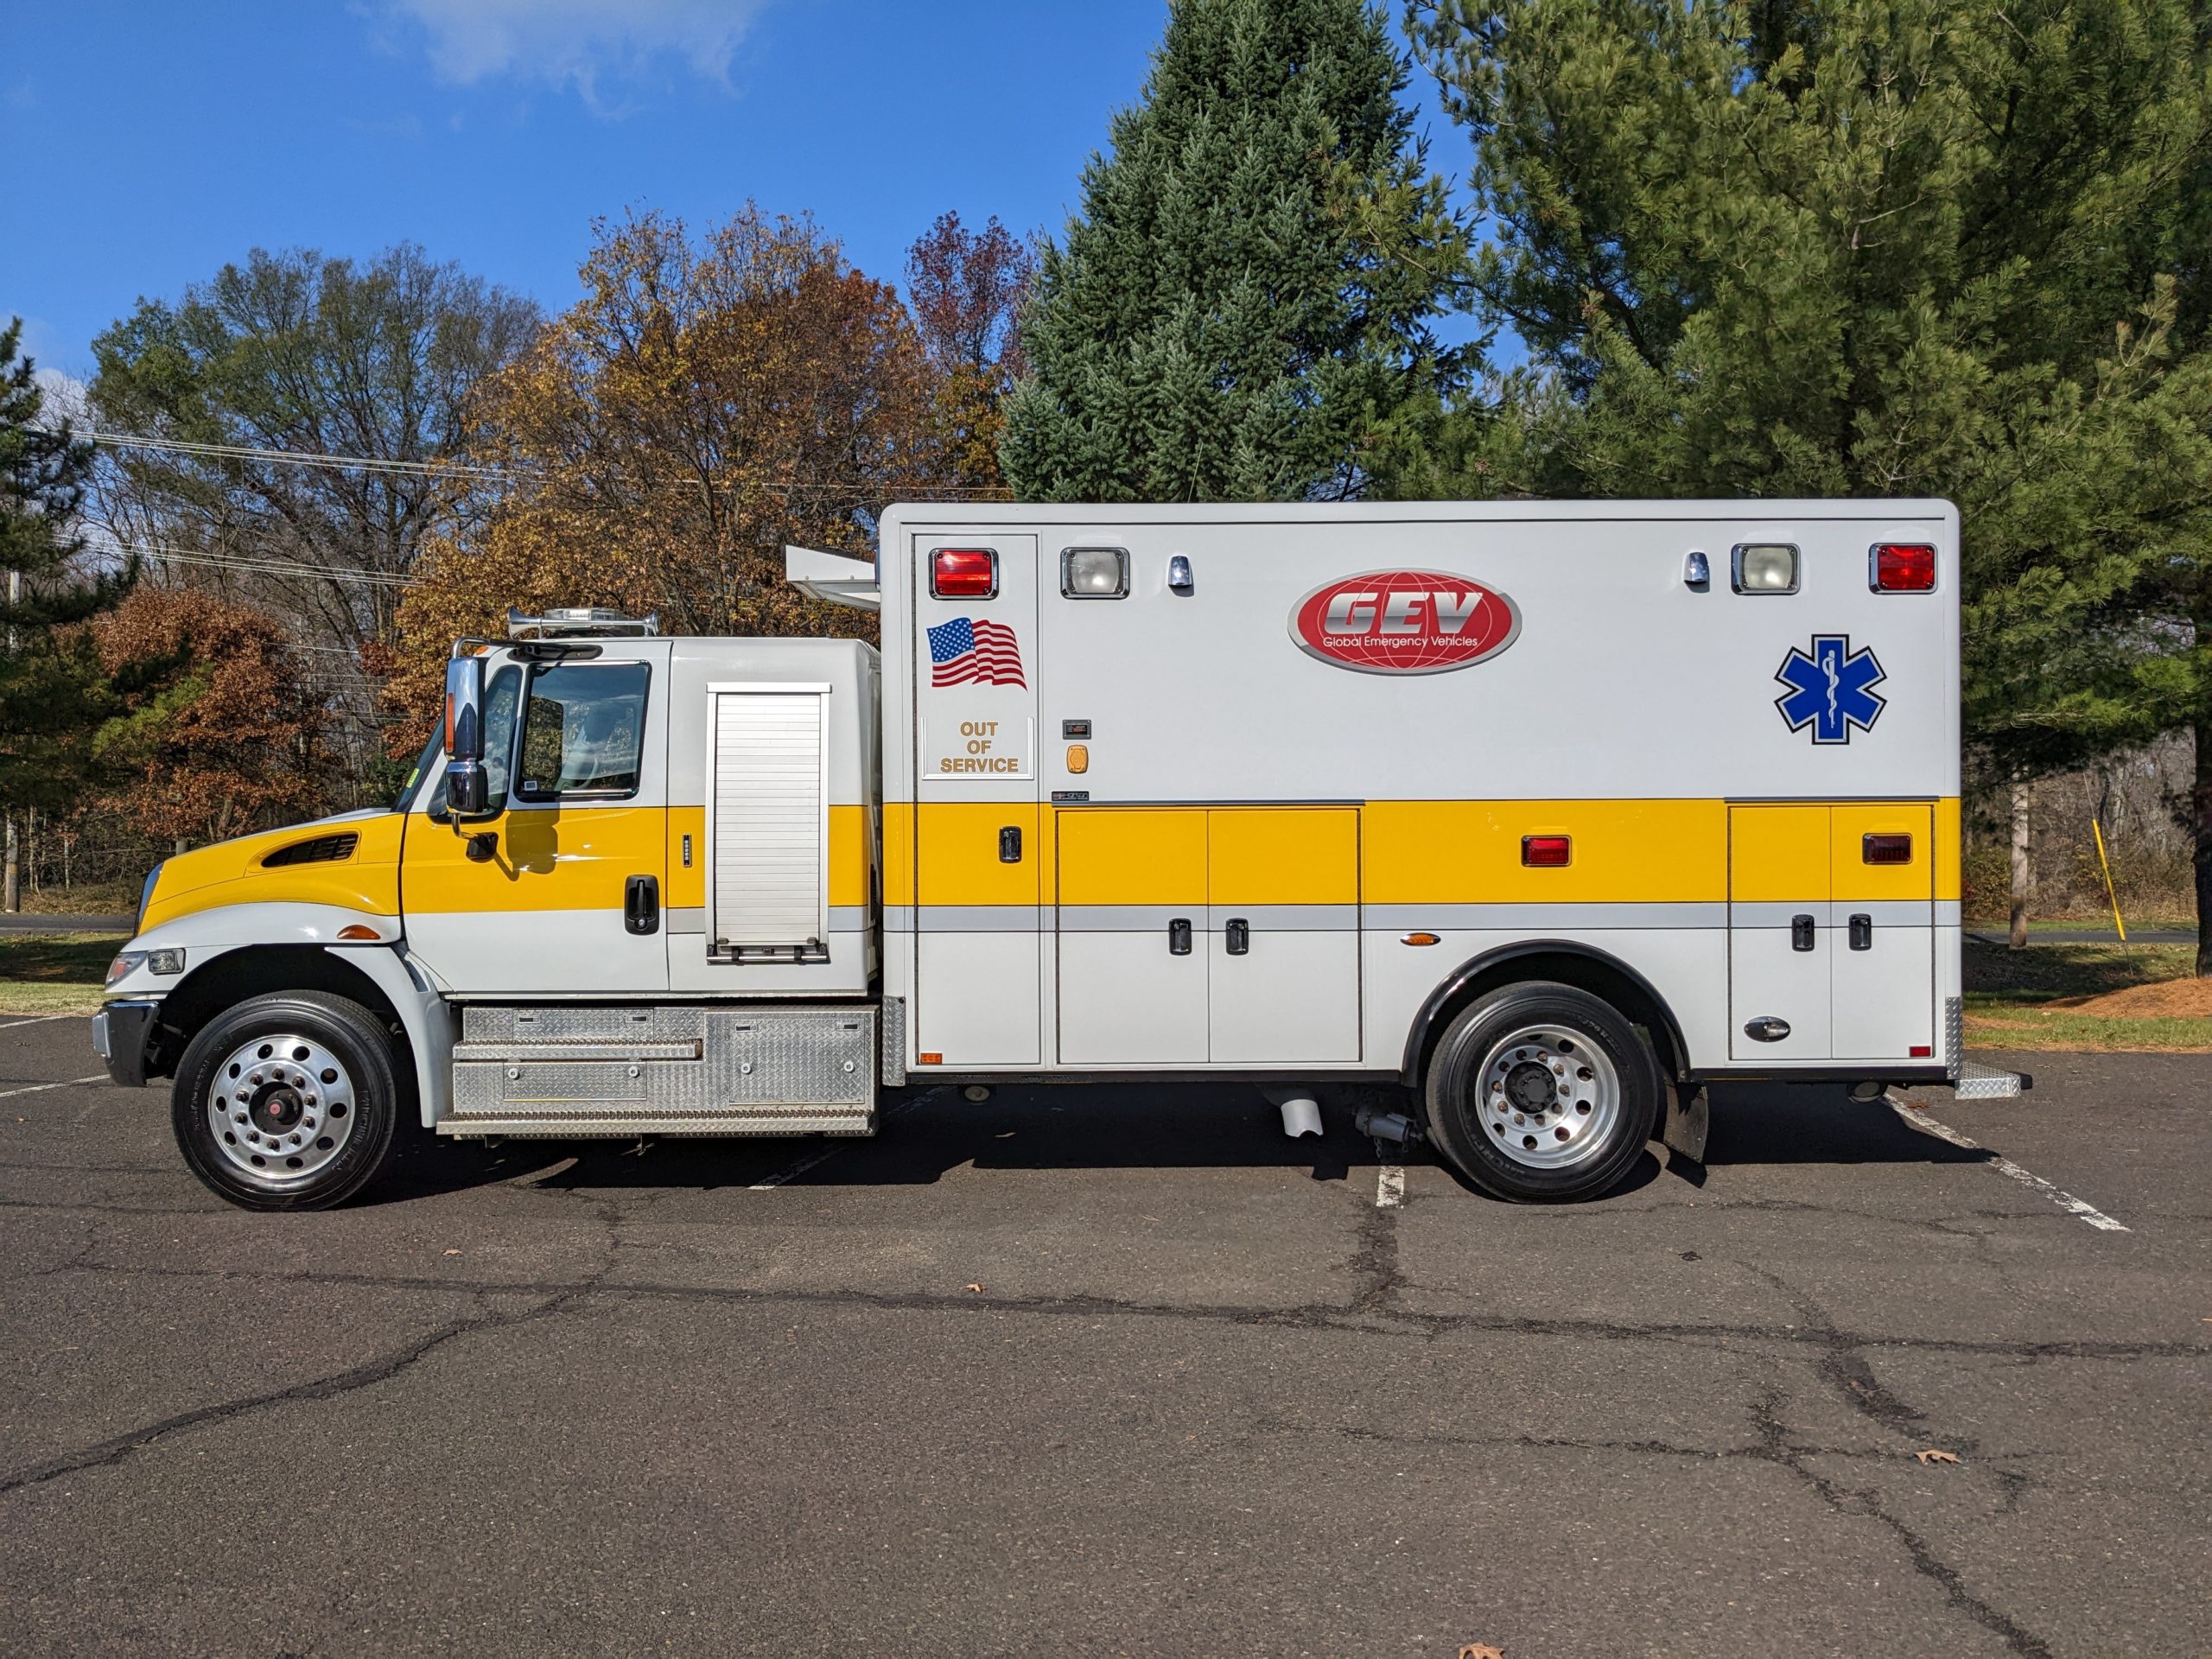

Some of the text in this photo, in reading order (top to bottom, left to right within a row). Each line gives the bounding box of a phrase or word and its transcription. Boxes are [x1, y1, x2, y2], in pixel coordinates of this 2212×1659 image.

[1324, 592, 1483, 634] GEV
[1323, 636, 1478, 648] Global Emergency Vehicles
[961, 721, 998, 736] OUT
[967, 741, 991, 754] OF
[940, 758, 1018, 772] SERVICE
